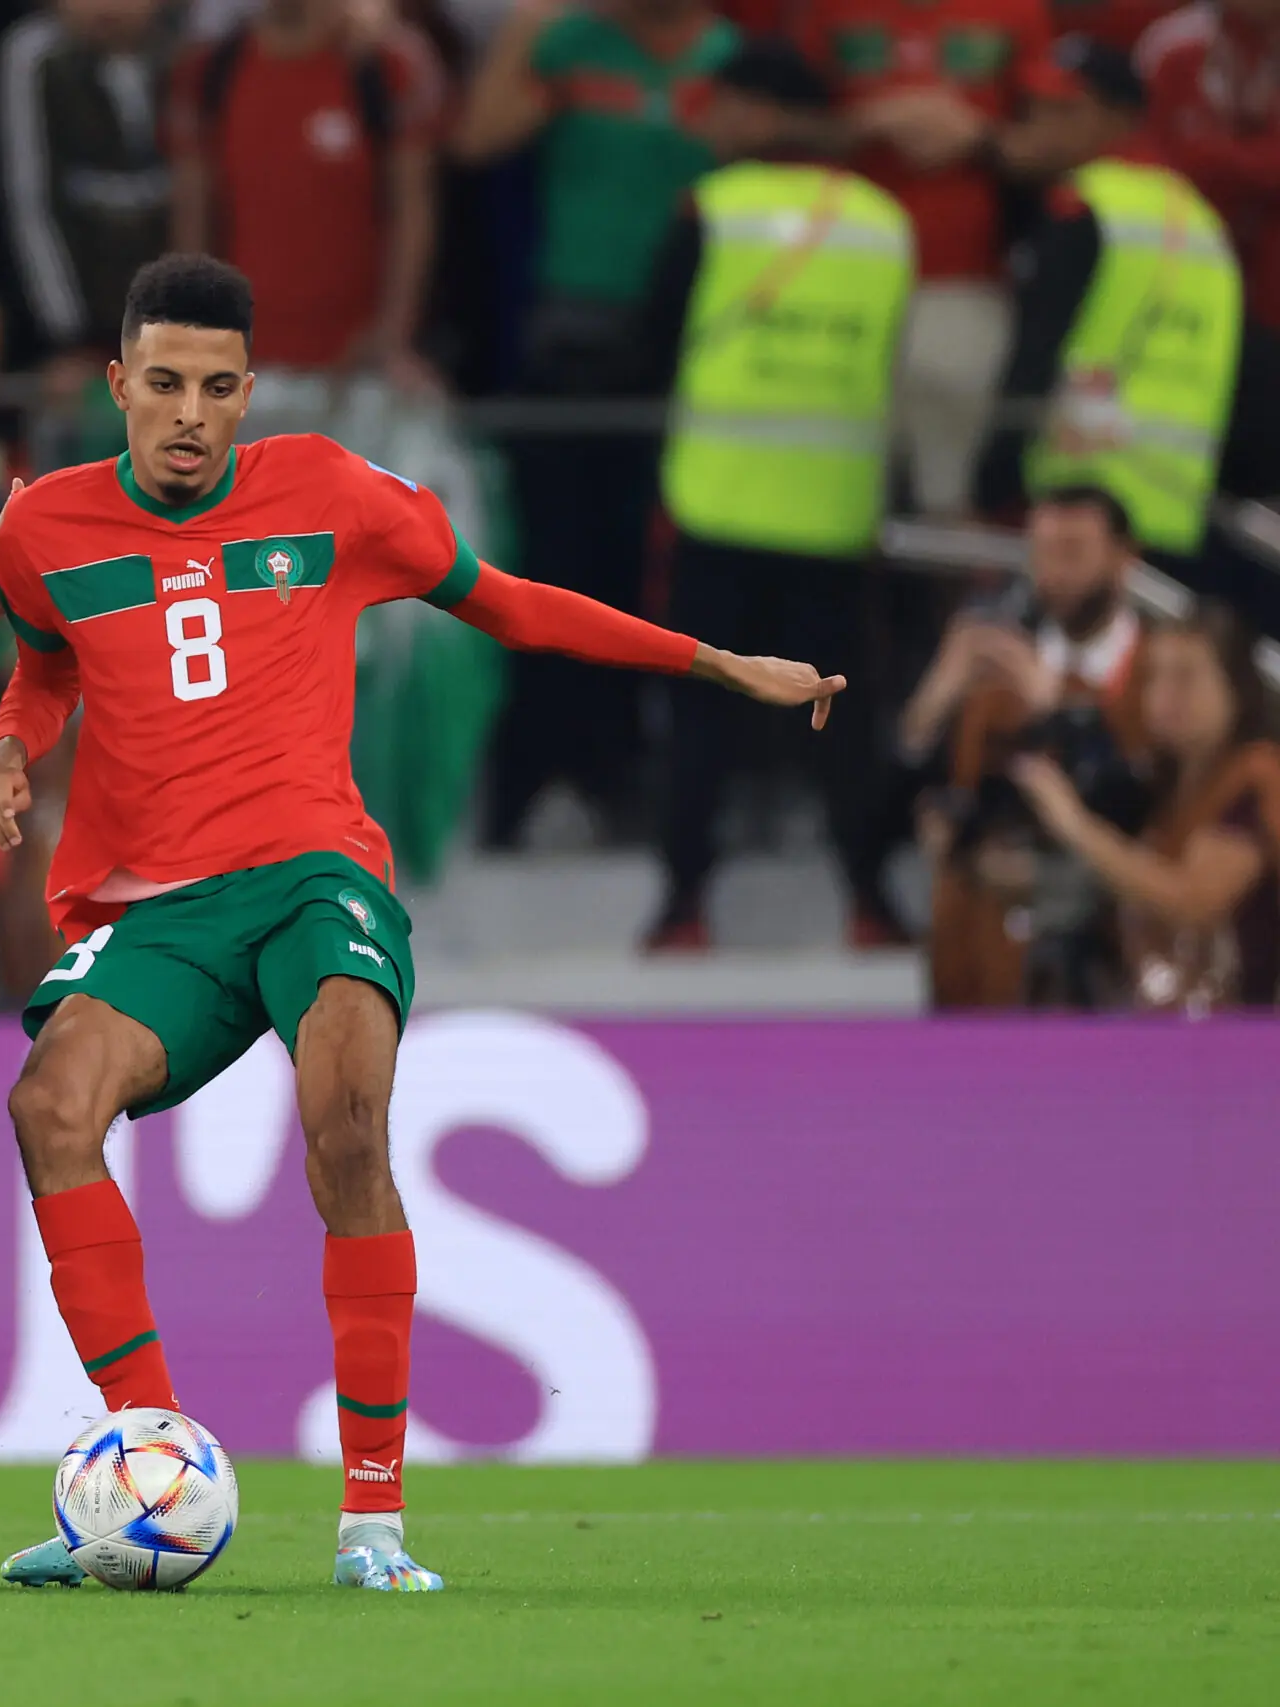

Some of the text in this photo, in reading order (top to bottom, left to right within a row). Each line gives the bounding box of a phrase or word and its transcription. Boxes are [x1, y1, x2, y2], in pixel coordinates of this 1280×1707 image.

[162, 571, 205, 593] PUMA
[165, 597, 228, 702] 8
[348, 1468, 389, 1483] PUMA
